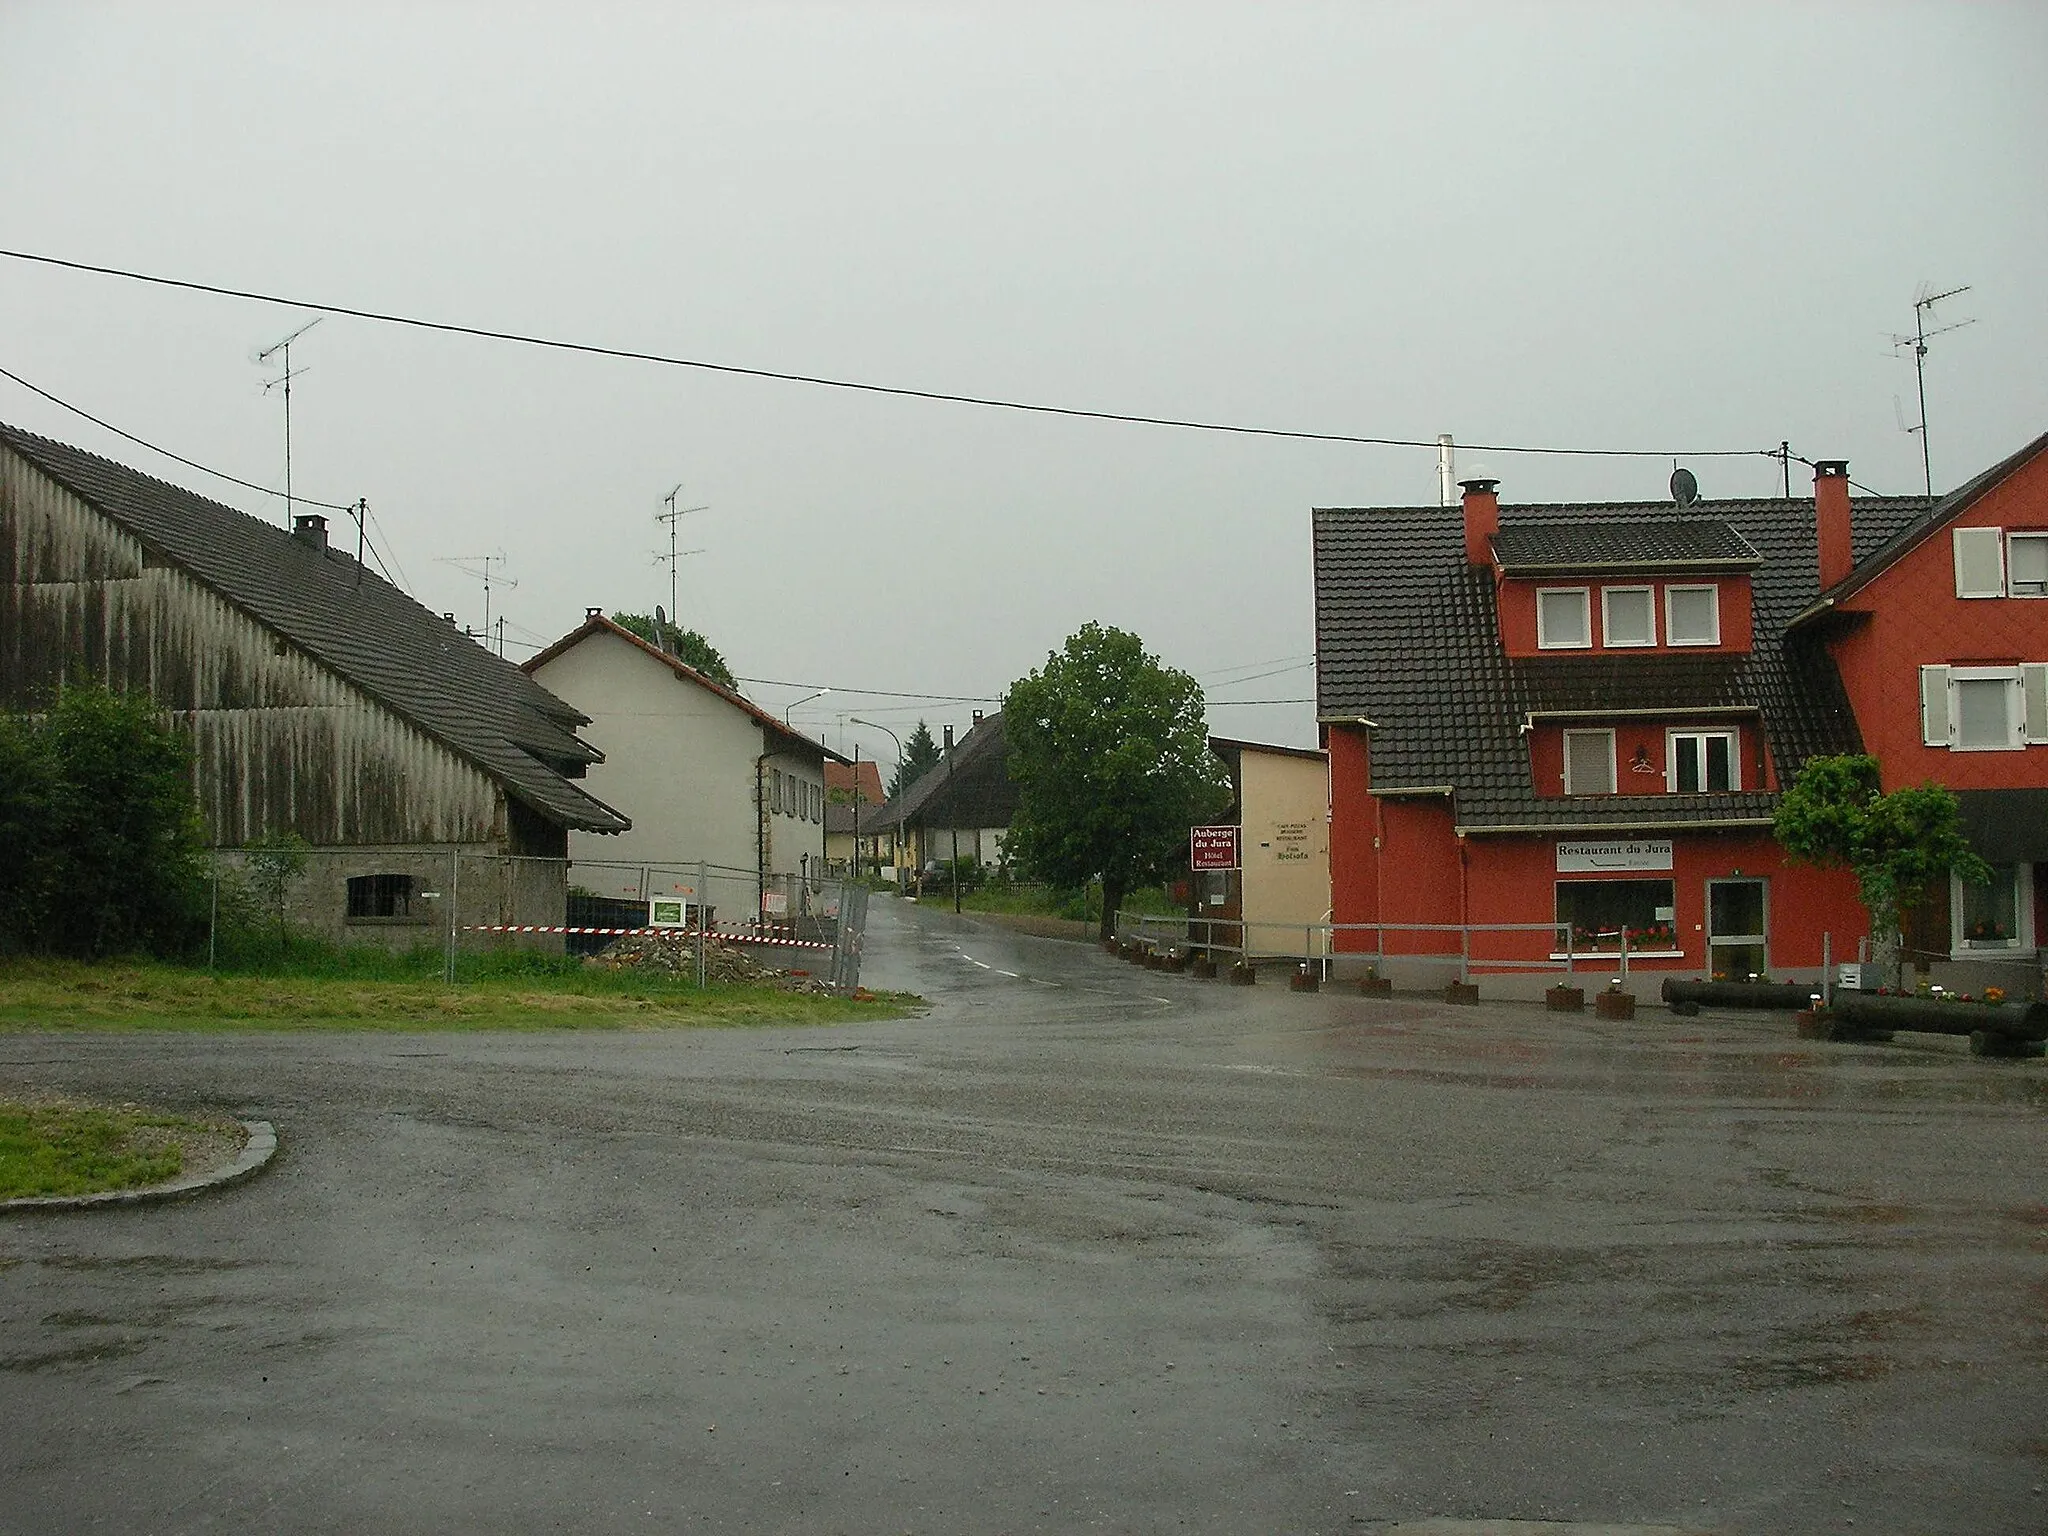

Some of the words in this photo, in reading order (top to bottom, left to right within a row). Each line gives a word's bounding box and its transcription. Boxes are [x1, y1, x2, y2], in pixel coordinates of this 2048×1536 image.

[1193, 829, 1233, 838] Auberge
[1195, 839, 1207, 847] du
[1210, 839, 1232, 847] Jura
[1558, 845, 1622, 855] Restaurant
[1627, 844, 1641, 854] du
[1645, 844, 1671, 854] Jura
